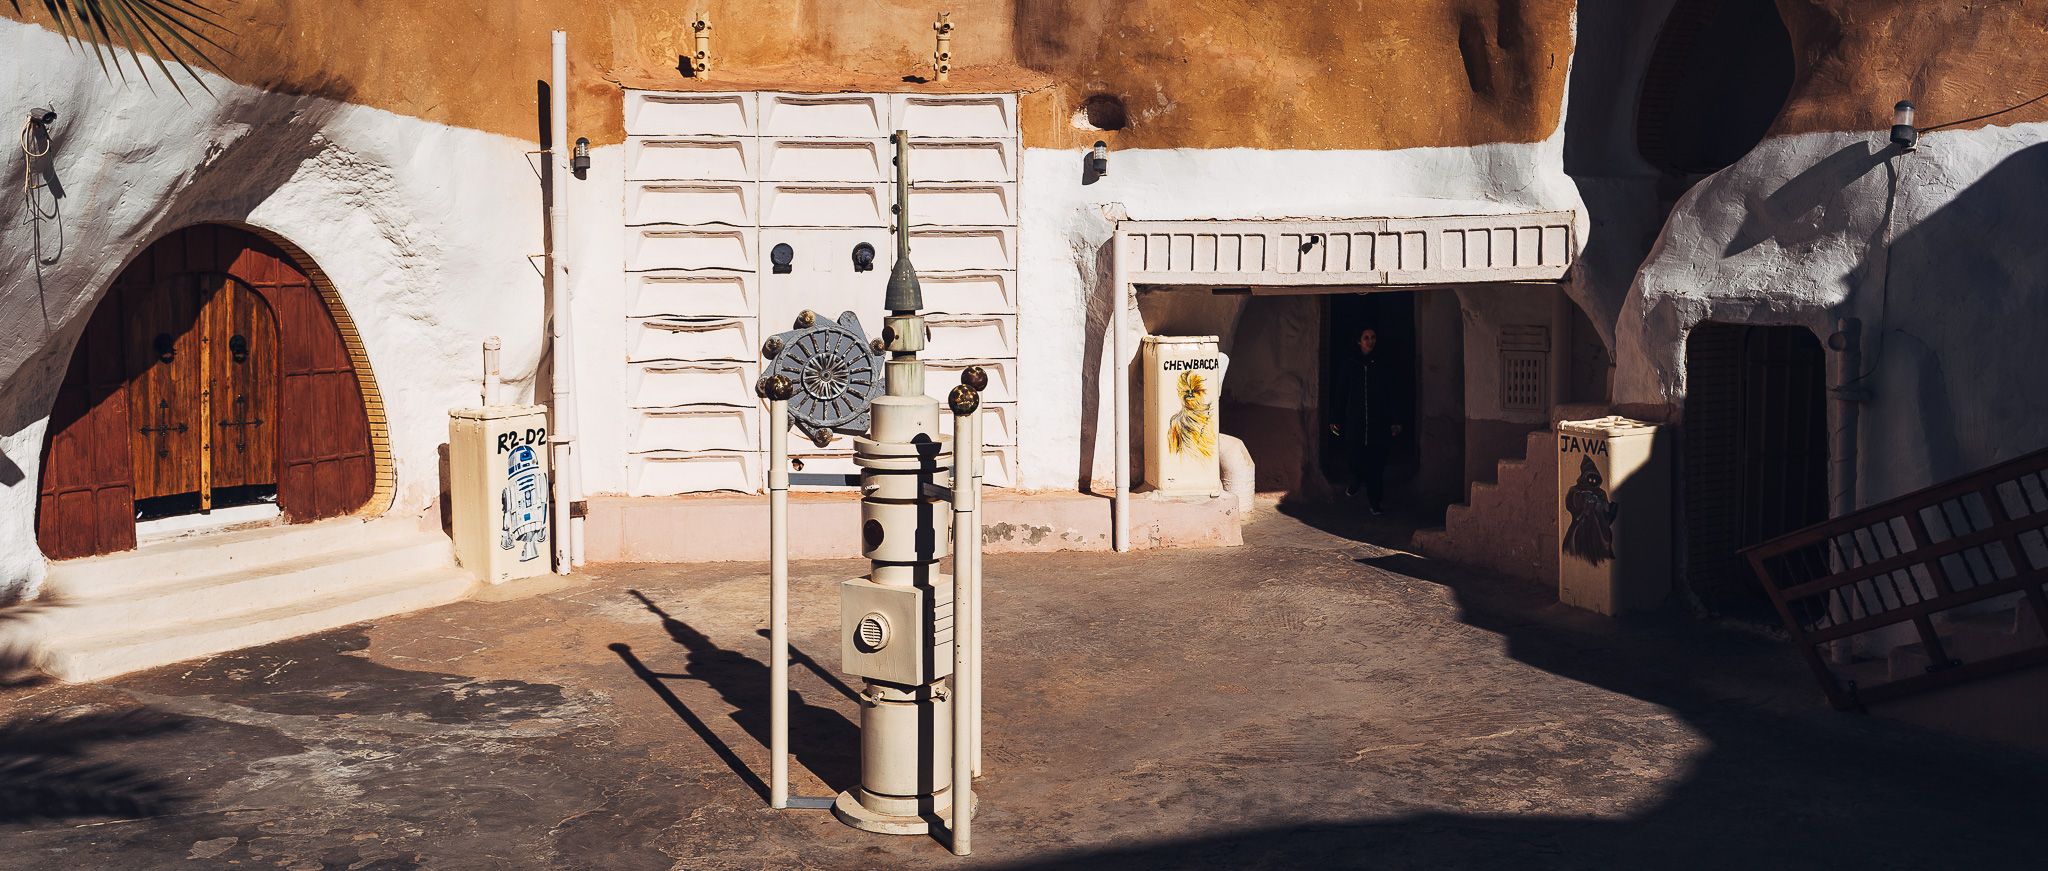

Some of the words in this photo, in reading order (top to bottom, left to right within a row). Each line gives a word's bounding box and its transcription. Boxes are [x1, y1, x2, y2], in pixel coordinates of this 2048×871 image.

[1163, 358, 1219, 371] CHEWBACCA
[497, 428, 547, 454] R2-D2
[1560, 435, 1609, 457] JAWA
